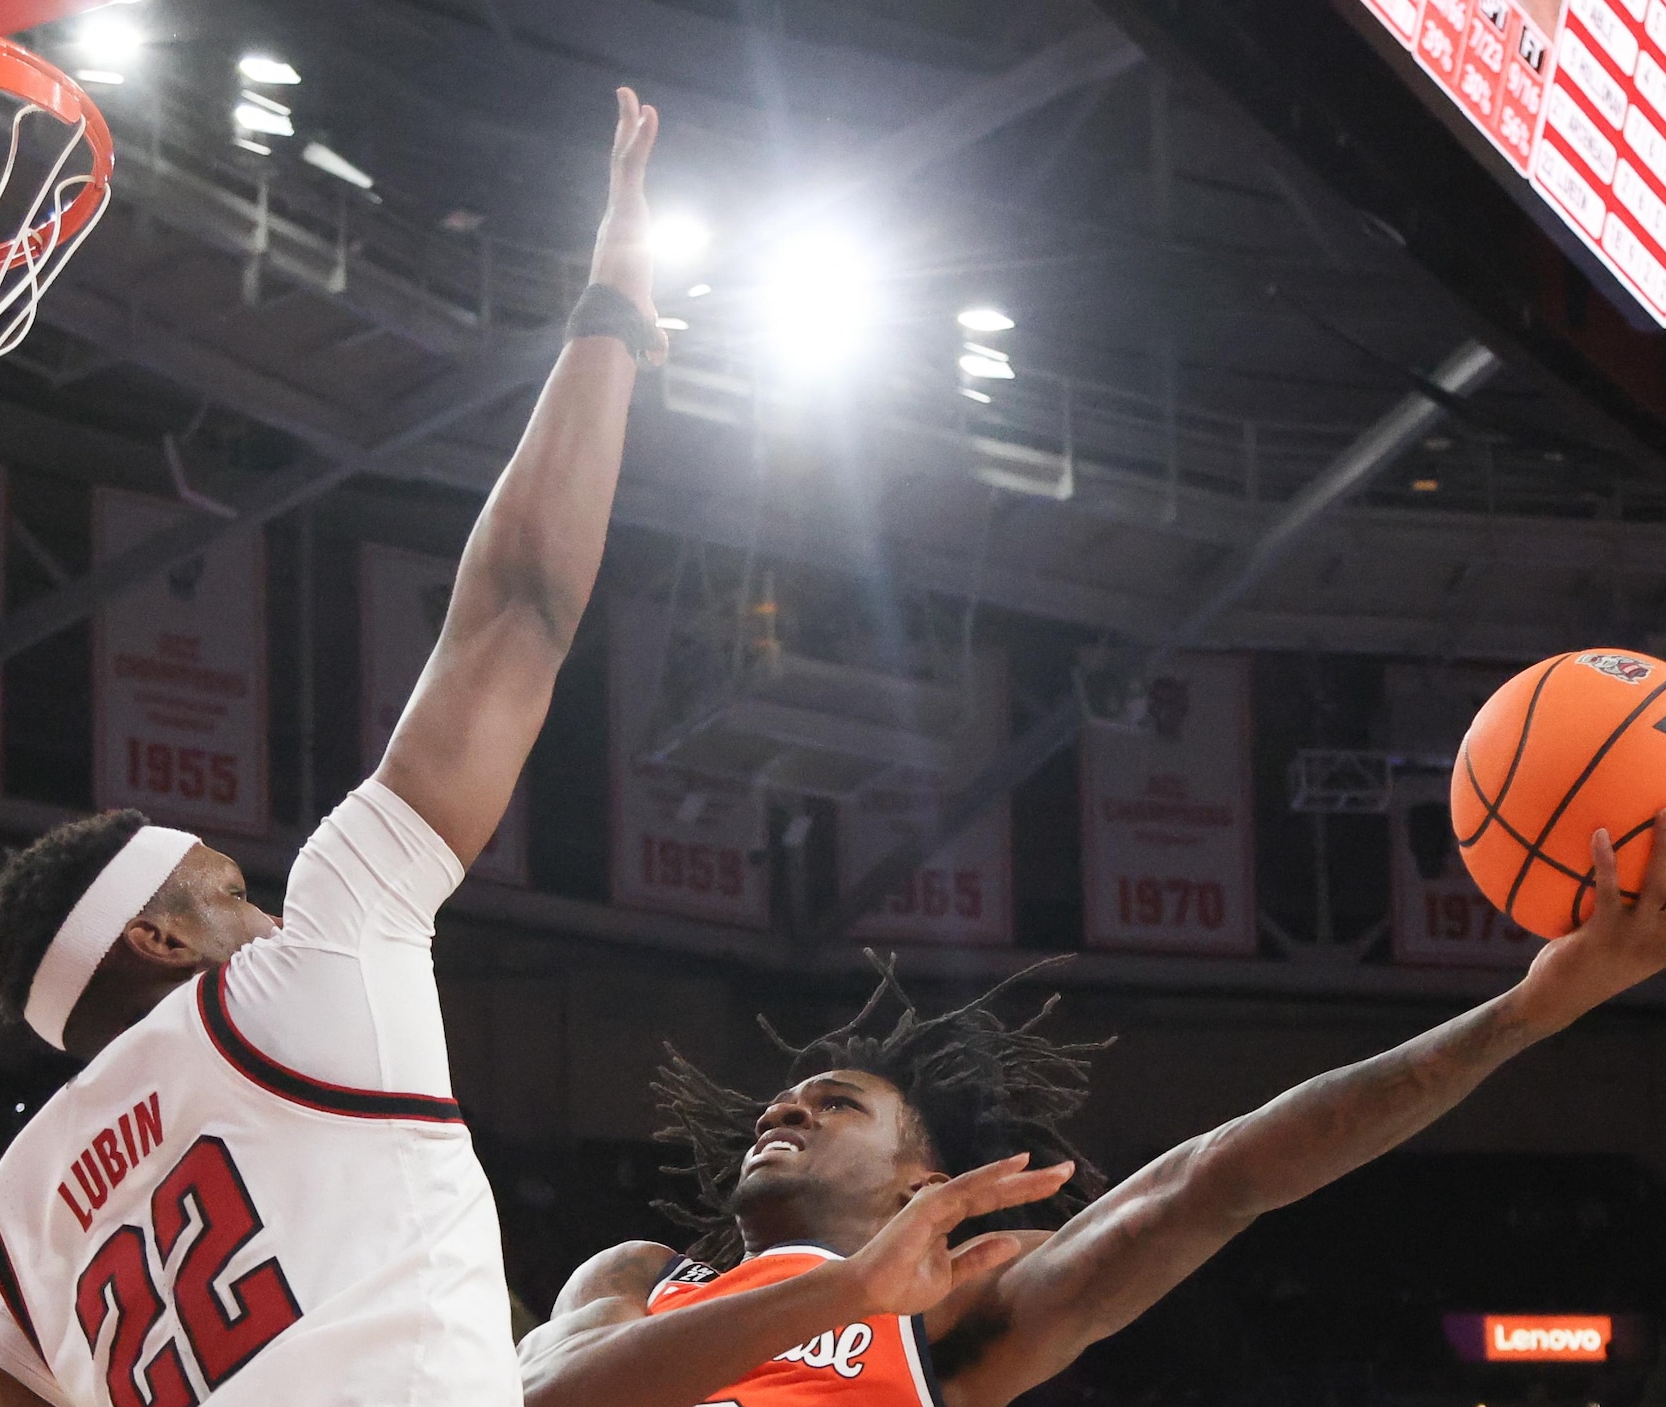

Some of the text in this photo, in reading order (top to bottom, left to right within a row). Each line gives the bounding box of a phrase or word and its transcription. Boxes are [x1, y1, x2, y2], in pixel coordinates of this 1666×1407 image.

[126, 736, 239, 806] 1955
[886, 868, 984, 920] 965
[1118, 876, 1225, 930] 1970
[58, 1091, 165, 1233] LUBIN
[1495, 1319, 1602, 1354] Lenovo
